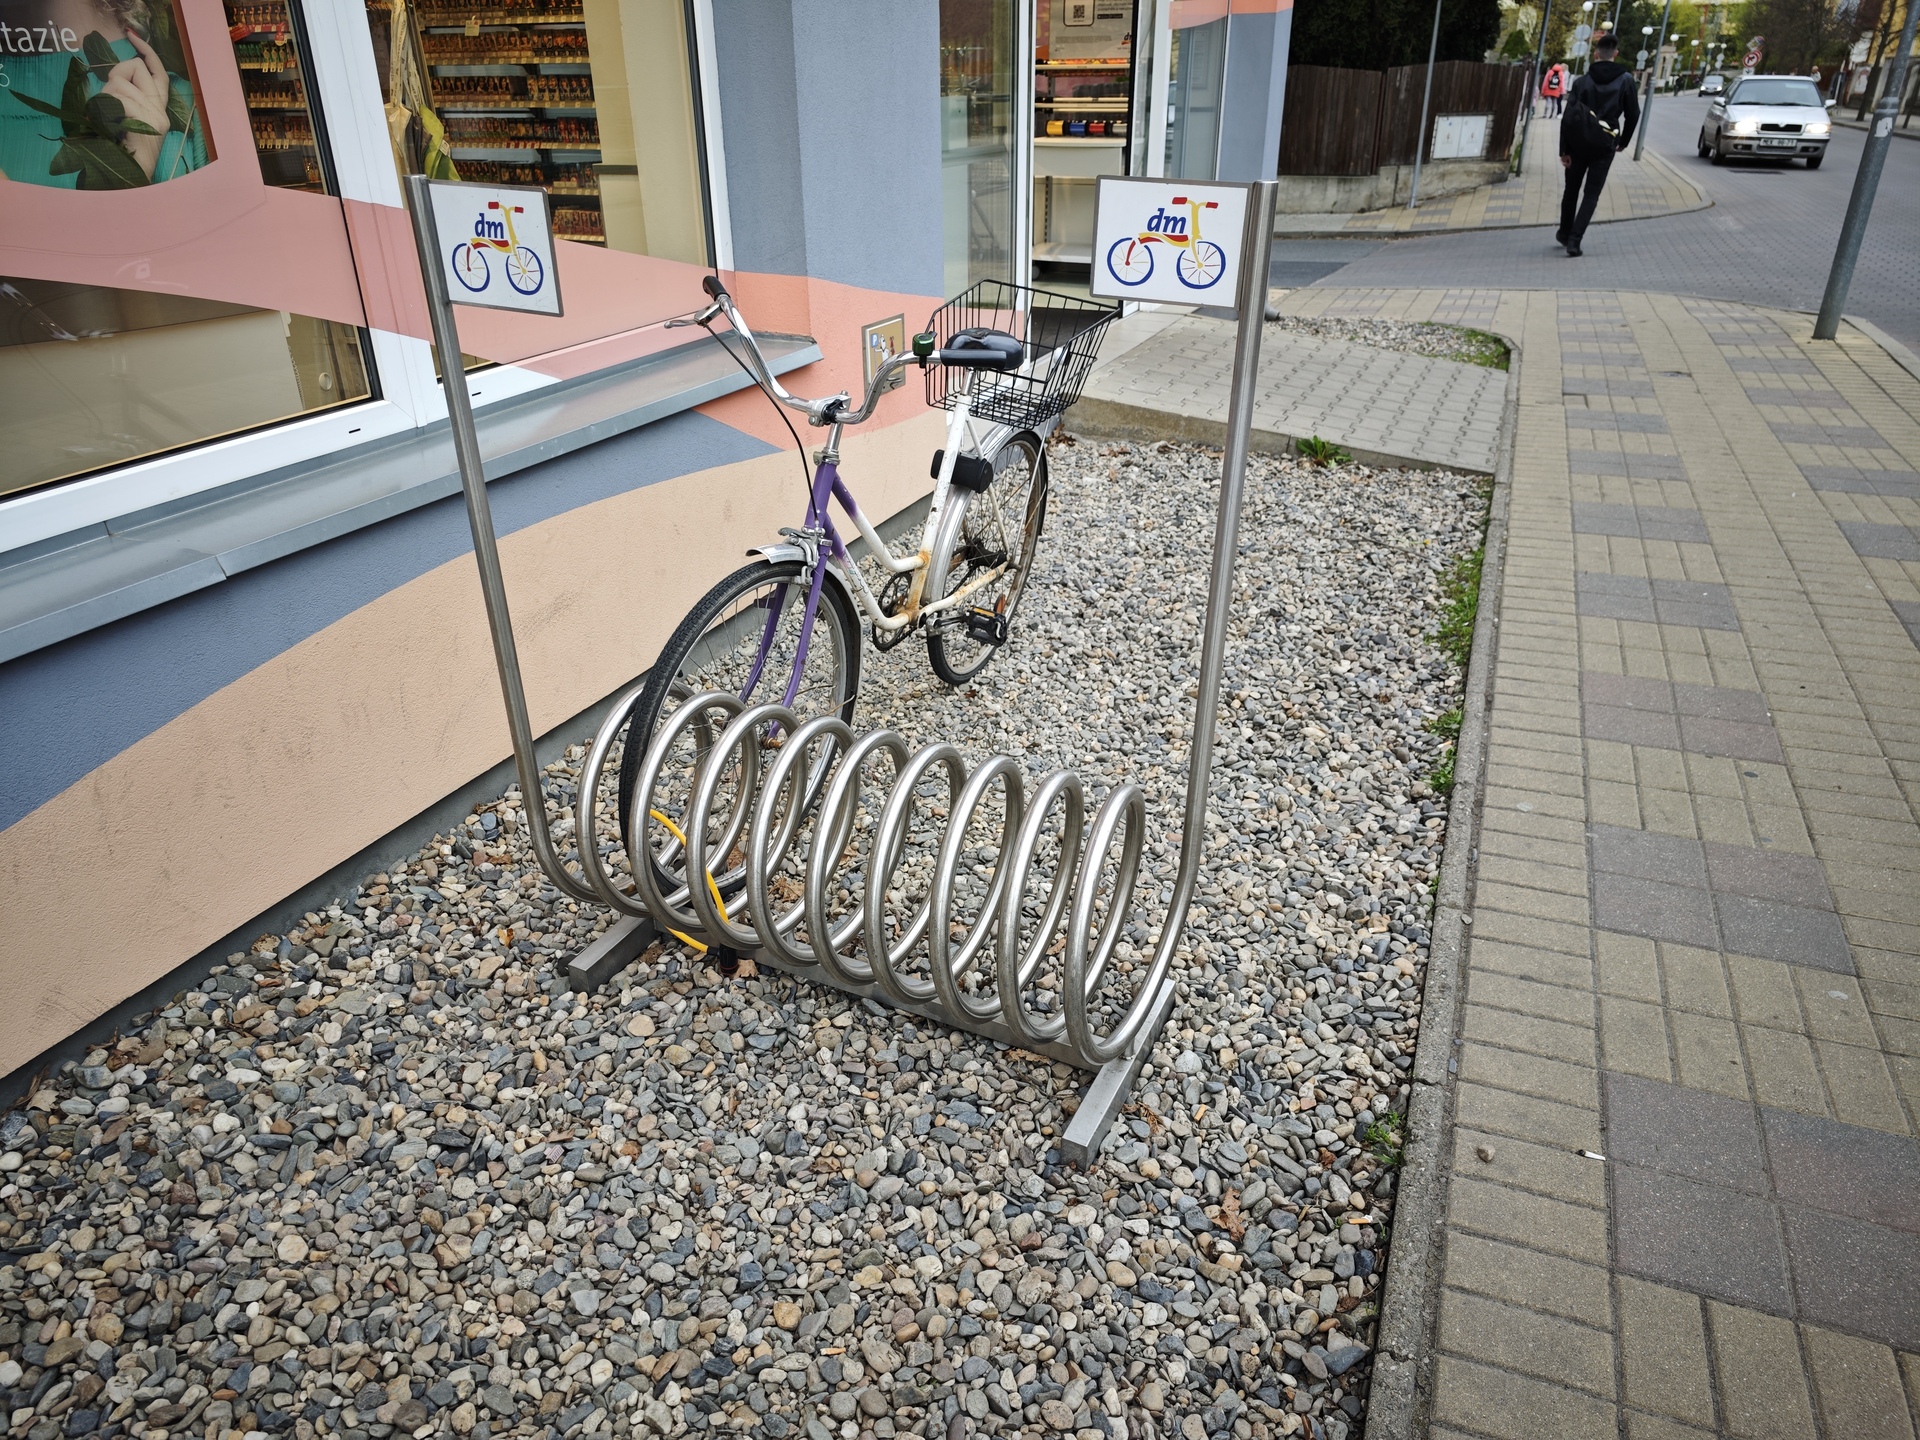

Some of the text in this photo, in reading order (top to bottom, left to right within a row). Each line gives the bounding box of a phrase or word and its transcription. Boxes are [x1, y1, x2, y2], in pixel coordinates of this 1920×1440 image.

[0, 20, 80, 53] tazie
[474, 212, 505, 240] dm
[1147, 207, 1187, 234] dm
